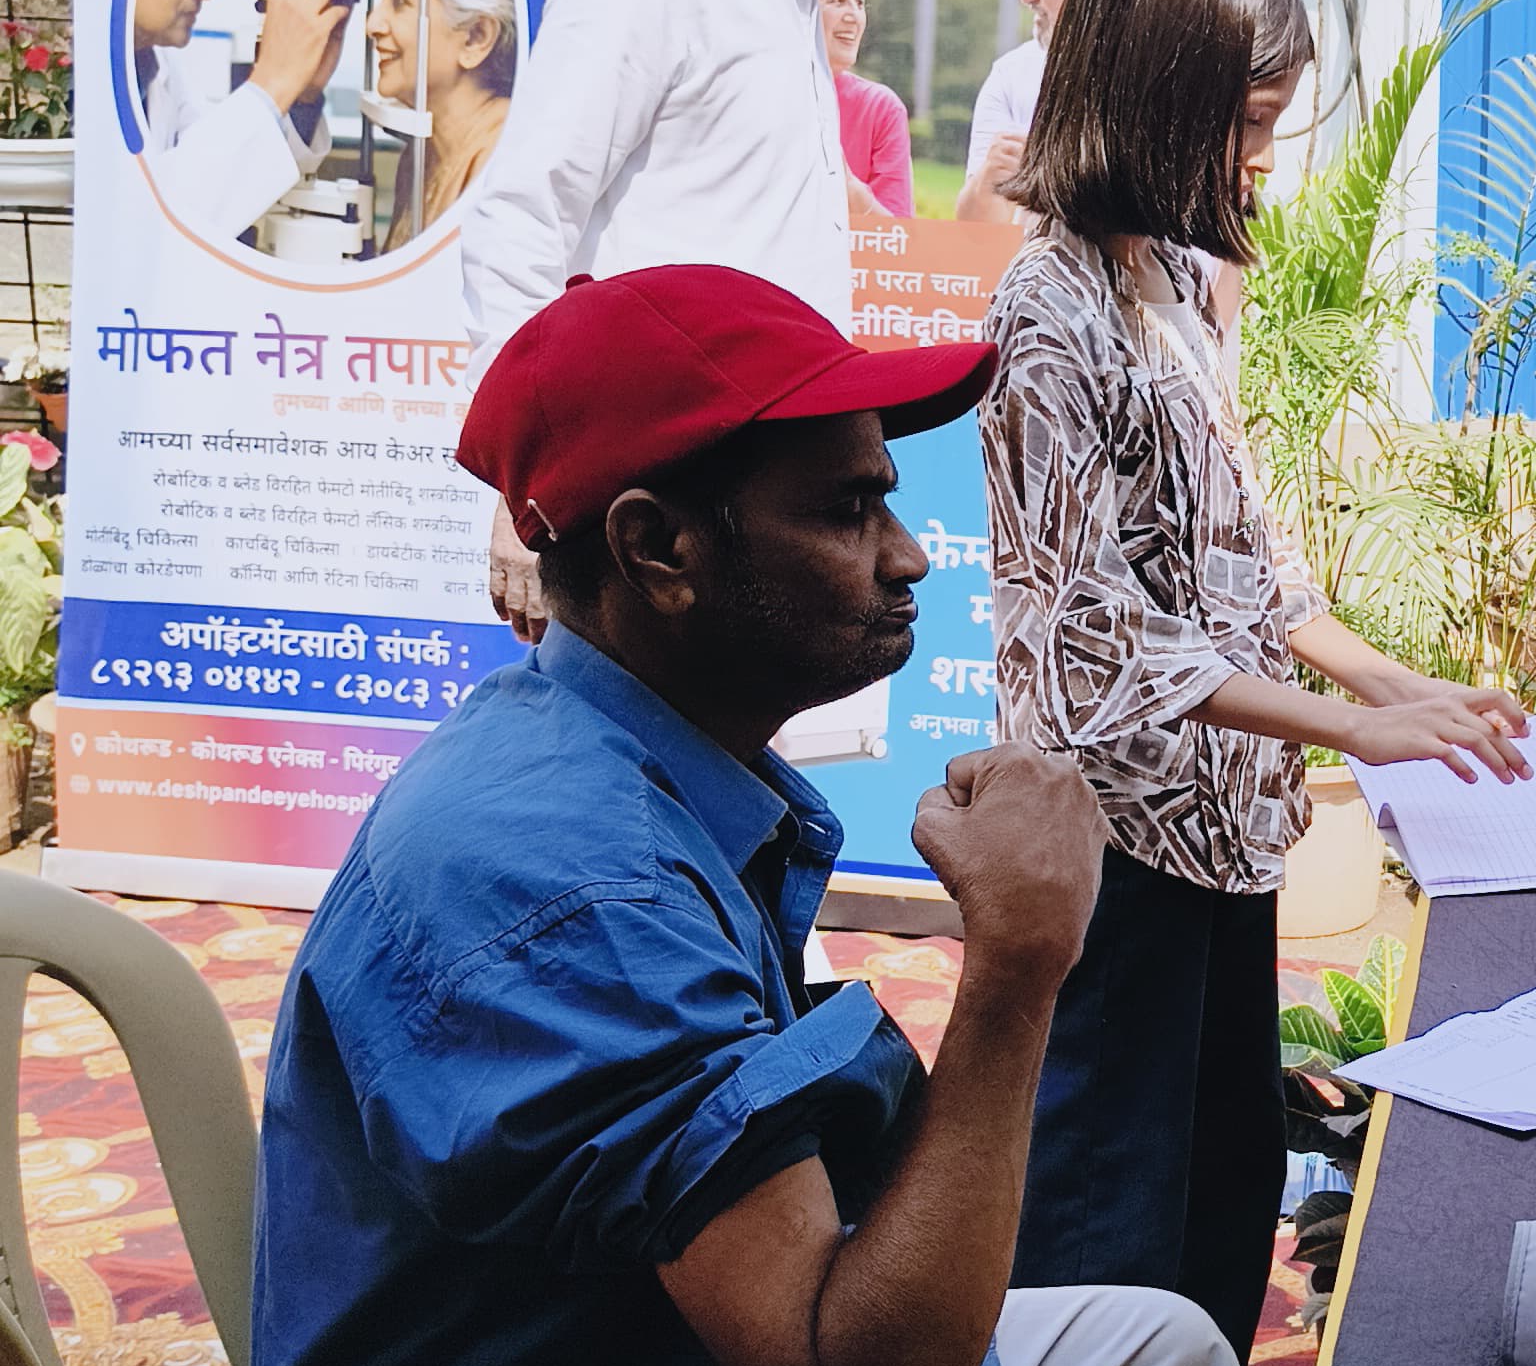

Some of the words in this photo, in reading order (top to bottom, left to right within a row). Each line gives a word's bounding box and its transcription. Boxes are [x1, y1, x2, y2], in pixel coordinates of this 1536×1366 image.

[875, 269, 924, 293] परत
[97, 308, 238, 375] मोफत
[254, 313, 328, 379] नेत्र
[272, 393, 329, 416] तुमच्या
[338, 391, 384, 414] आणि
[392, 398, 446, 421] तुमच्या
[118, 431, 192, 451] आमच्या
[202, 428, 327, 458] सर्वसमावेशक
[337, 440, 376, 460] आय
[387, 437, 433, 463] केअर
[154, 471, 212, 488] रोबोटिक
[266, 473, 310, 496] विरहित
[161, 499, 217, 518] रोबोटिक
[272, 503, 316, 526] विरहित
[136, 529, 198, 549] चिकित्सा
[285, 535, 339, 557] चिकित्सा
[283, 565, 318, 585] आणि
[365, 570, 419, 592] चिकित्सा
[160, 616, 368, 662] अपॉइंटमेंटसाठी
[375, 629, 451, 667] संपर्क
[460, 644, 469, 670] :
[91, 659, 193, 691] ८९२९३
[205, 664, 301, 696] ०४१४२
[336, 673, 430, 708] ८३०८३
[910, 714, 979, 739] अनुभवा
[95, 731, 172, 758] कोथरूड
[191, 736, 263, 765] कोथरूड
[268, 741, 325, 770] एनेक्स
